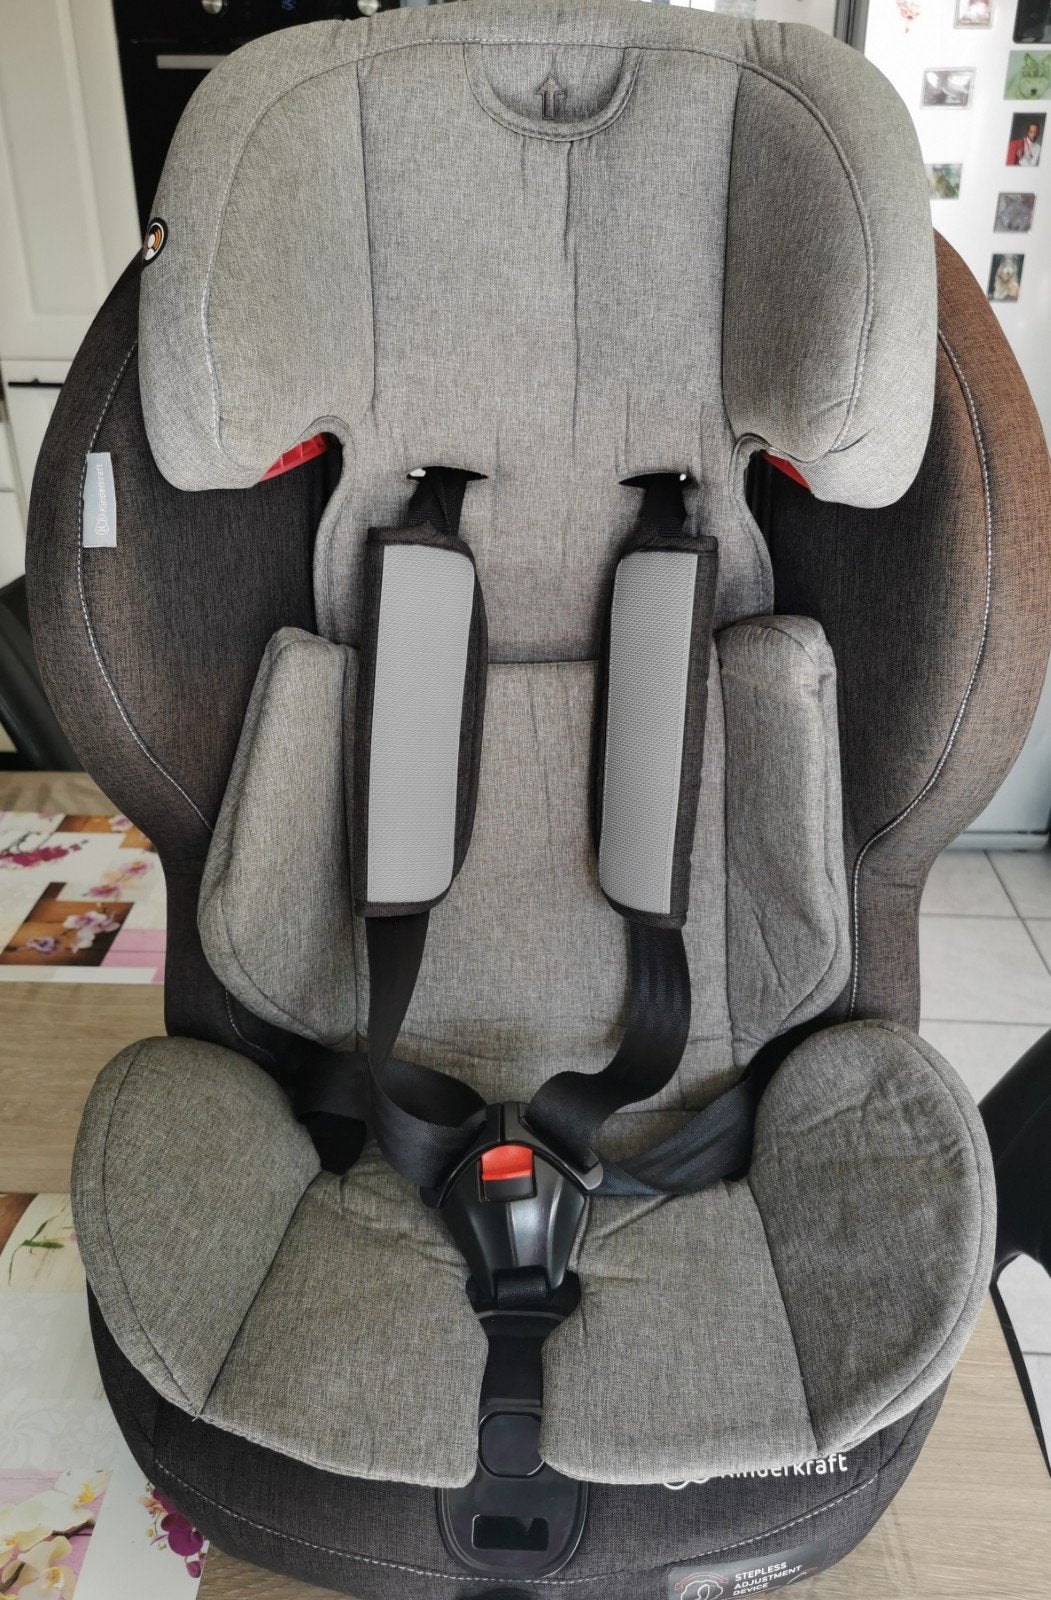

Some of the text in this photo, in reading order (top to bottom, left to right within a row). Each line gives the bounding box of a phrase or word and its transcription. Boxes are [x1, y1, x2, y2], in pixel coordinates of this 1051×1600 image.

[96, 463, 107, 512] Kinderkraft
[721, 1453, 848, 1478] erkraft
[733, 1565, 803, 1589] ADJUSTMENT
[734, 1562, 787, 1581] STEPLESS
[732, 1583, 769, 1596] DEVICE
